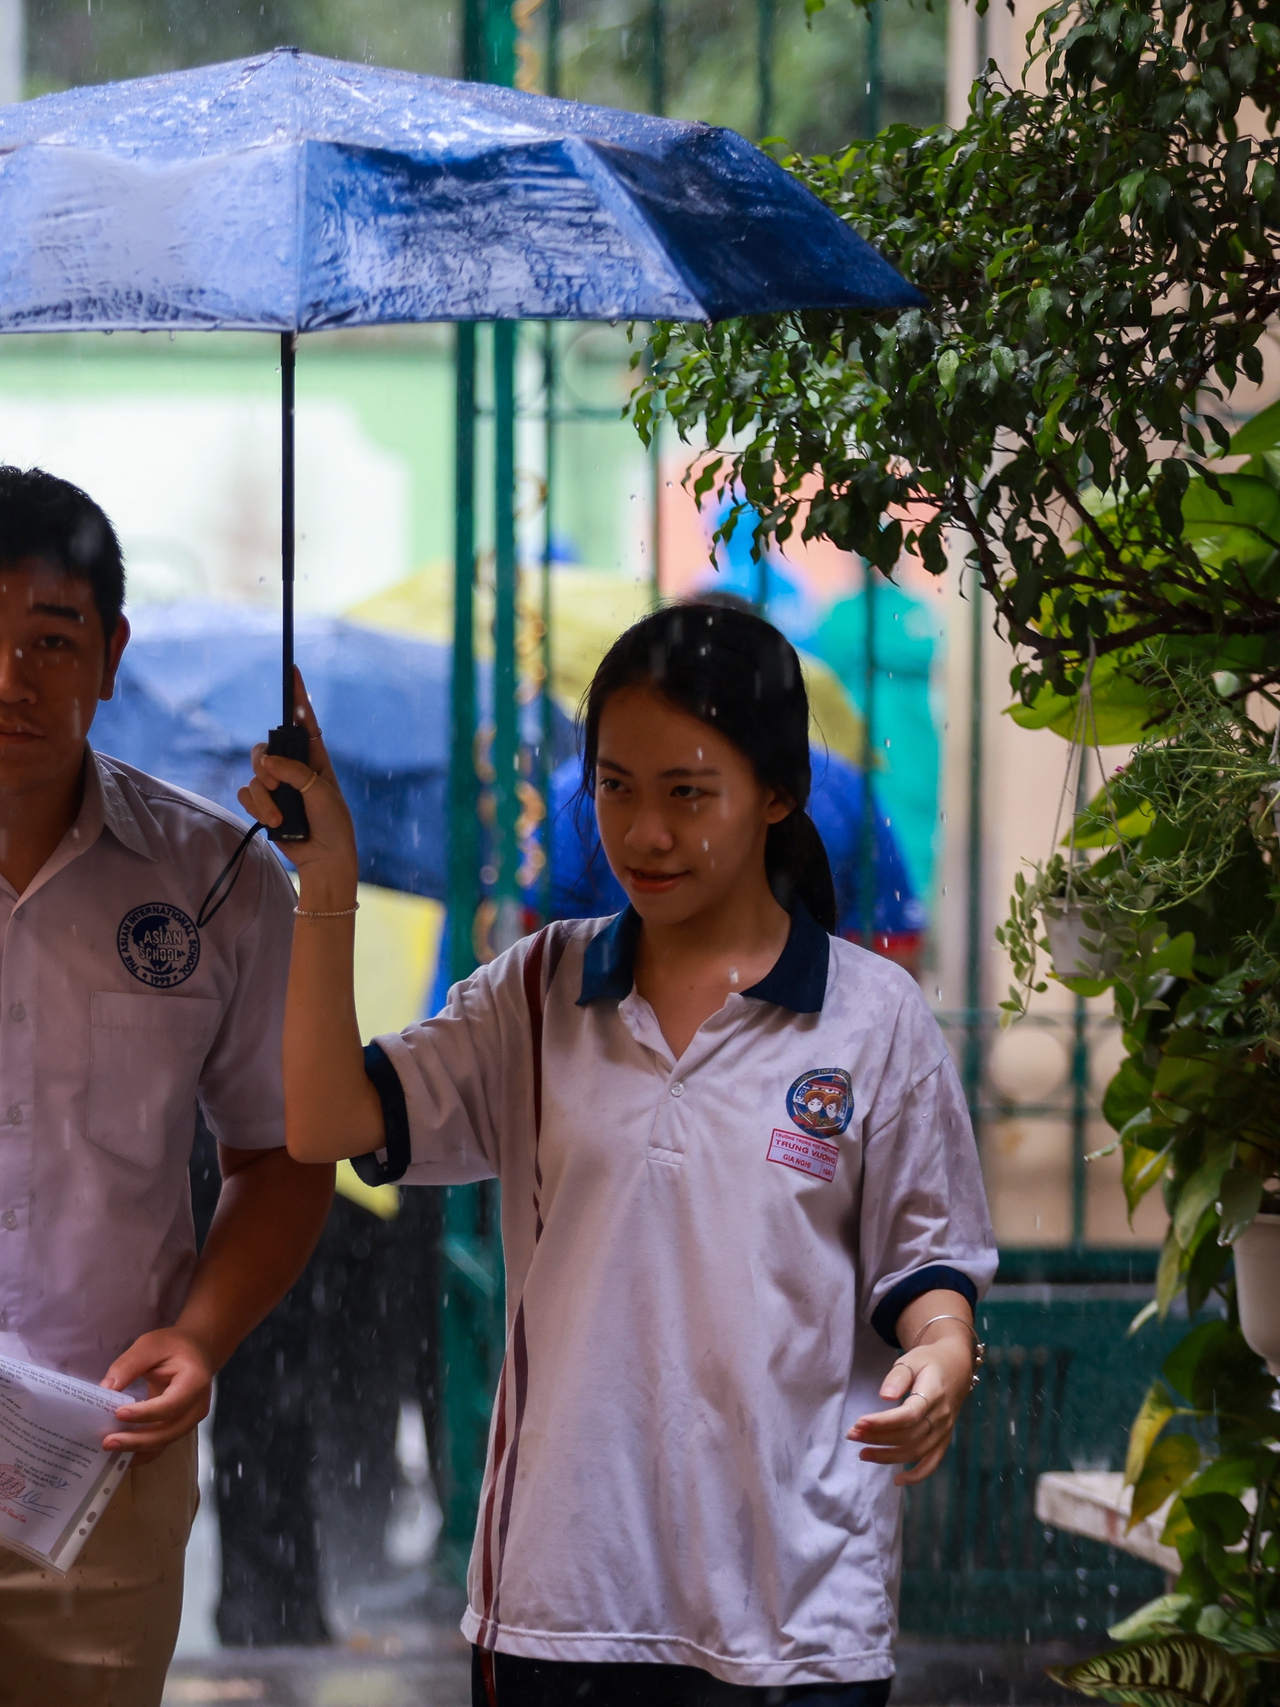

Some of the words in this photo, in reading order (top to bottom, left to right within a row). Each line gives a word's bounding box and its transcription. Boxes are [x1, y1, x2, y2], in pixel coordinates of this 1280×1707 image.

[127, 906, 195, 937] INTERNATIONAL
[120, 925, 131, 953] ASIAN
[143, 930, 183, 945] ASIAN
[124, 955, 140, 974] THE
[139, 947, 180, 962] SCHOOL
[179, 939, 198, 976] SCHOOL
